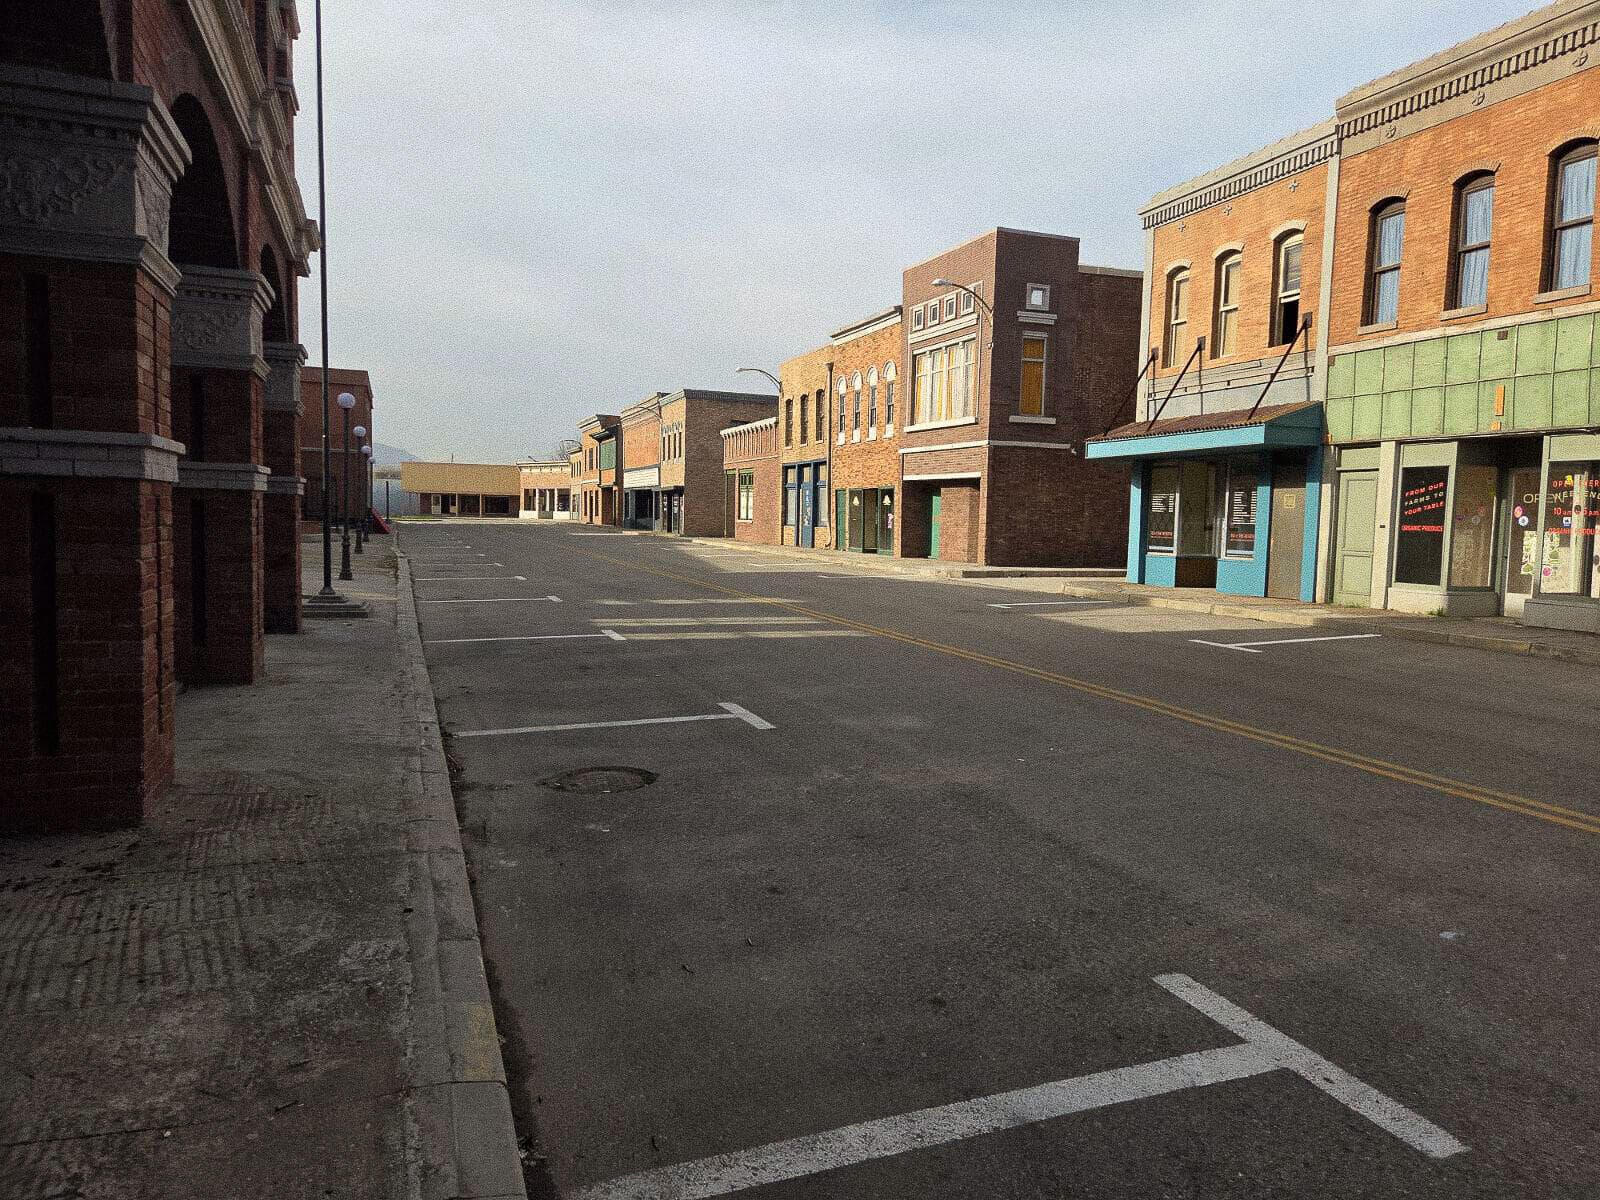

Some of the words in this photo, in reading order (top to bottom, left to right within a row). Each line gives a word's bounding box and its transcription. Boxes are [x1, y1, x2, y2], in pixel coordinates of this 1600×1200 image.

[1405, 487, 1426, 496] FROM
[1429, 482, 1443, 490] OUR
[1405, 495, 1430, 506] FARMS
[1405, 507, 1421, 515] YOUR
[1424, 501, 1444, 510] TABLE
